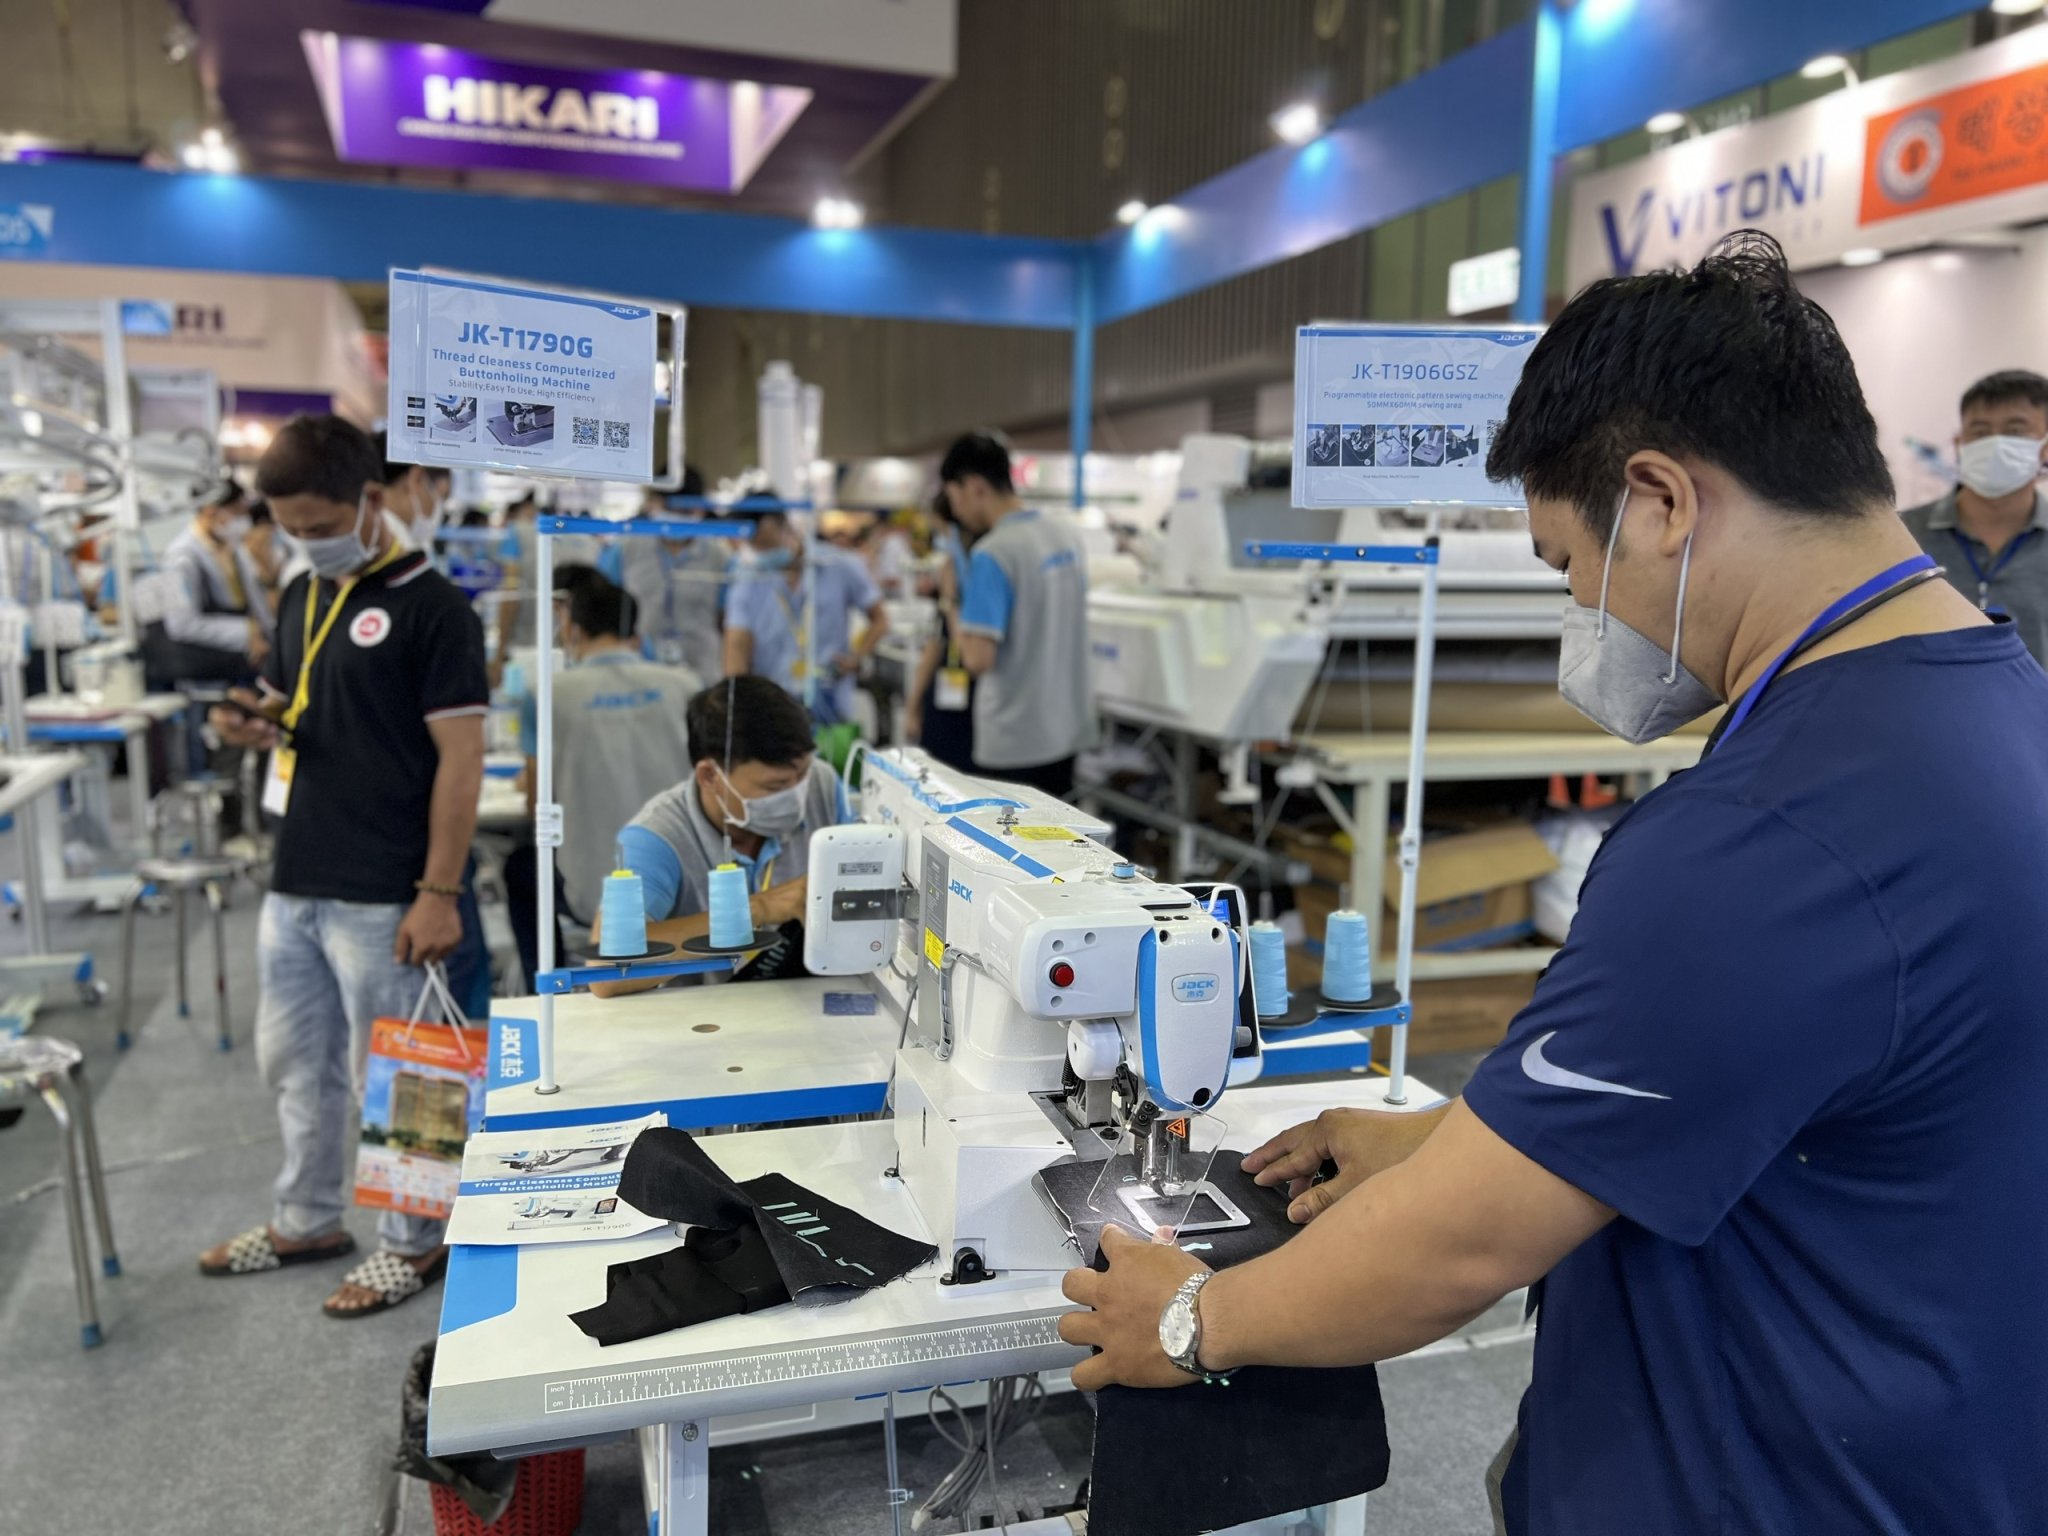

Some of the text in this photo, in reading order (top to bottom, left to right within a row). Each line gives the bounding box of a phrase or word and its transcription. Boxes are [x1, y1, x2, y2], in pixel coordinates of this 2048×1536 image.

[423, 75, 659, 140] HIKARI
[1667, 152, 1825, 238] VITONI
[458, 322, 593, 358] JK-T1790G
[432, 349, 616, 380] Thread Cleaness Computerized
[1352, 363, 1479, 380] JK-T1906GSZ
[459, 367, 591, 391] Buttonholing Machine
[507, 386, 516, 394] To
[537, 389, 555, 399] High
[557, 391, 595, 404] Efficiency
[1323, 391, 1378, 401] Programmable
[1379, 391, 1415, 400] electronic
[1417, 392, 1444, 401] pattern
[1445, 393, 1472, 401] sewing
[1367, 401, 1417, 409] 50MMX60MM
[1418, 402, 1445, 410] sewing
[474, 1173, 621, 1188] Thread Cleaness Comput
[499, 1179, 620, 1192] Buttonholing Machi
